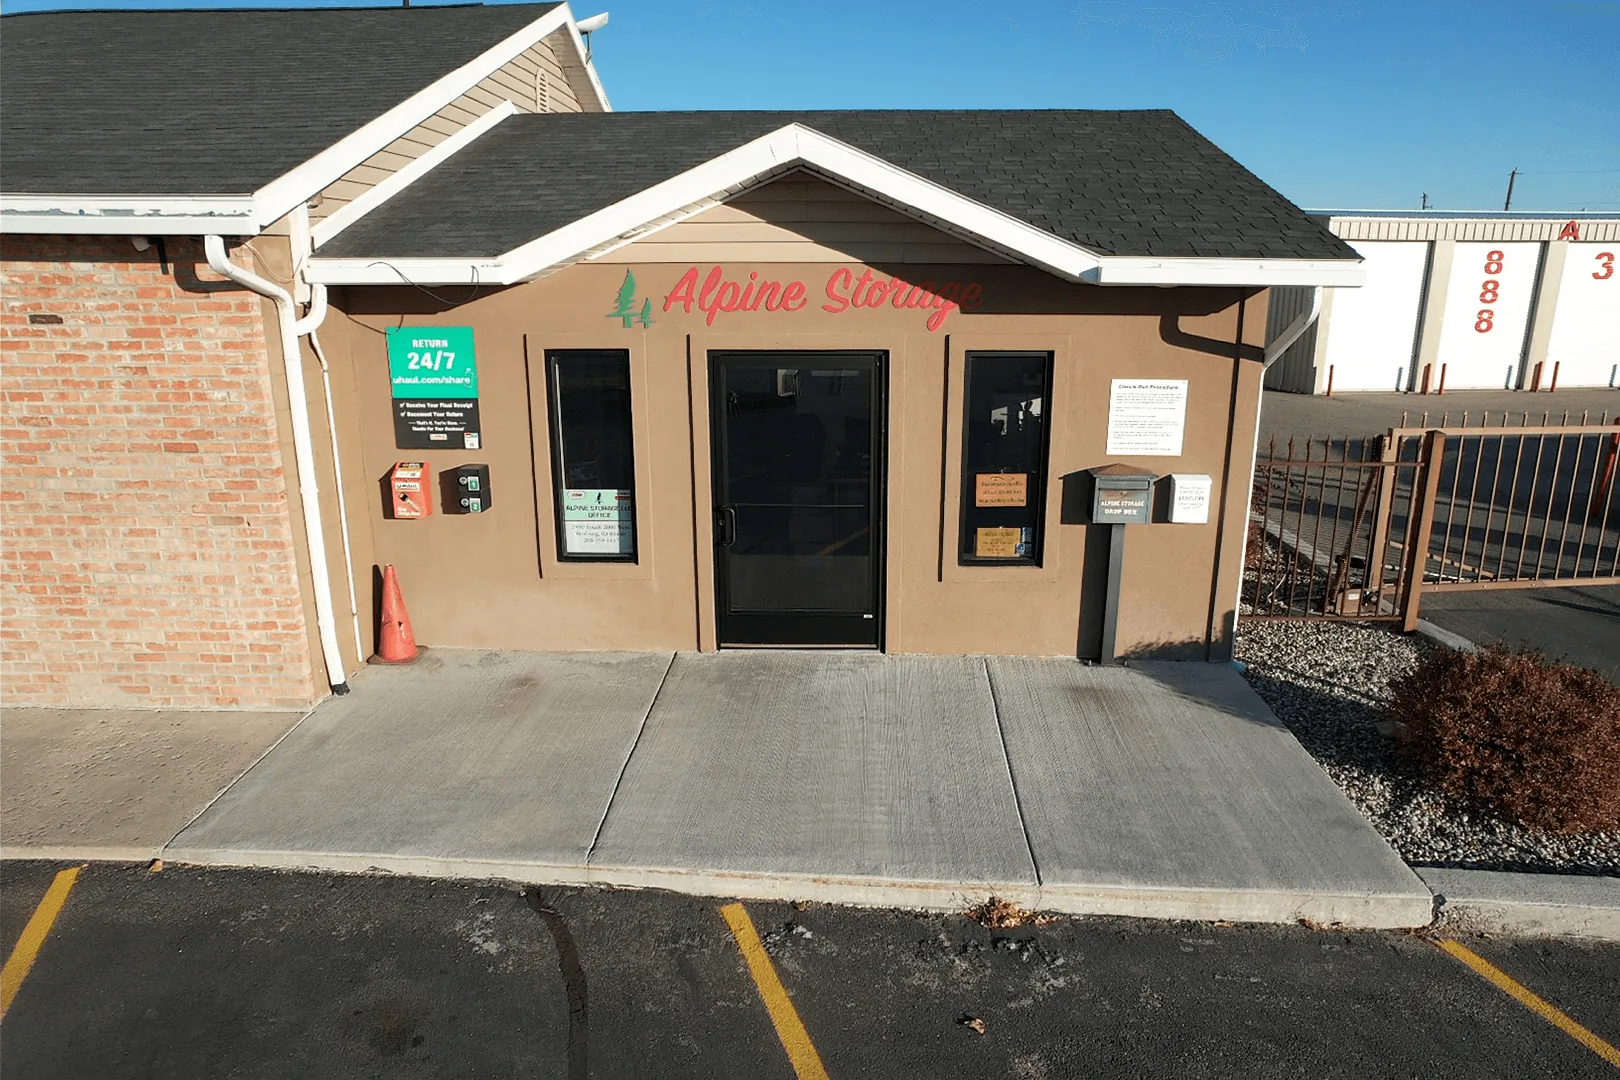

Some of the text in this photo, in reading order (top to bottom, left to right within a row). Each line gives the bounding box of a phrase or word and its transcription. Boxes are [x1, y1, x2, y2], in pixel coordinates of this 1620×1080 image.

[1557, 220, 1579, 240] A
[1592, 252, 1615, 280] 3
[663, 265, 983, 331] Alpine Storage
[412, 339, 448, 348] RETURN
[407, 350, 455, 370] 24/7
[392, 376, 471, 384] uhaul.com/share
